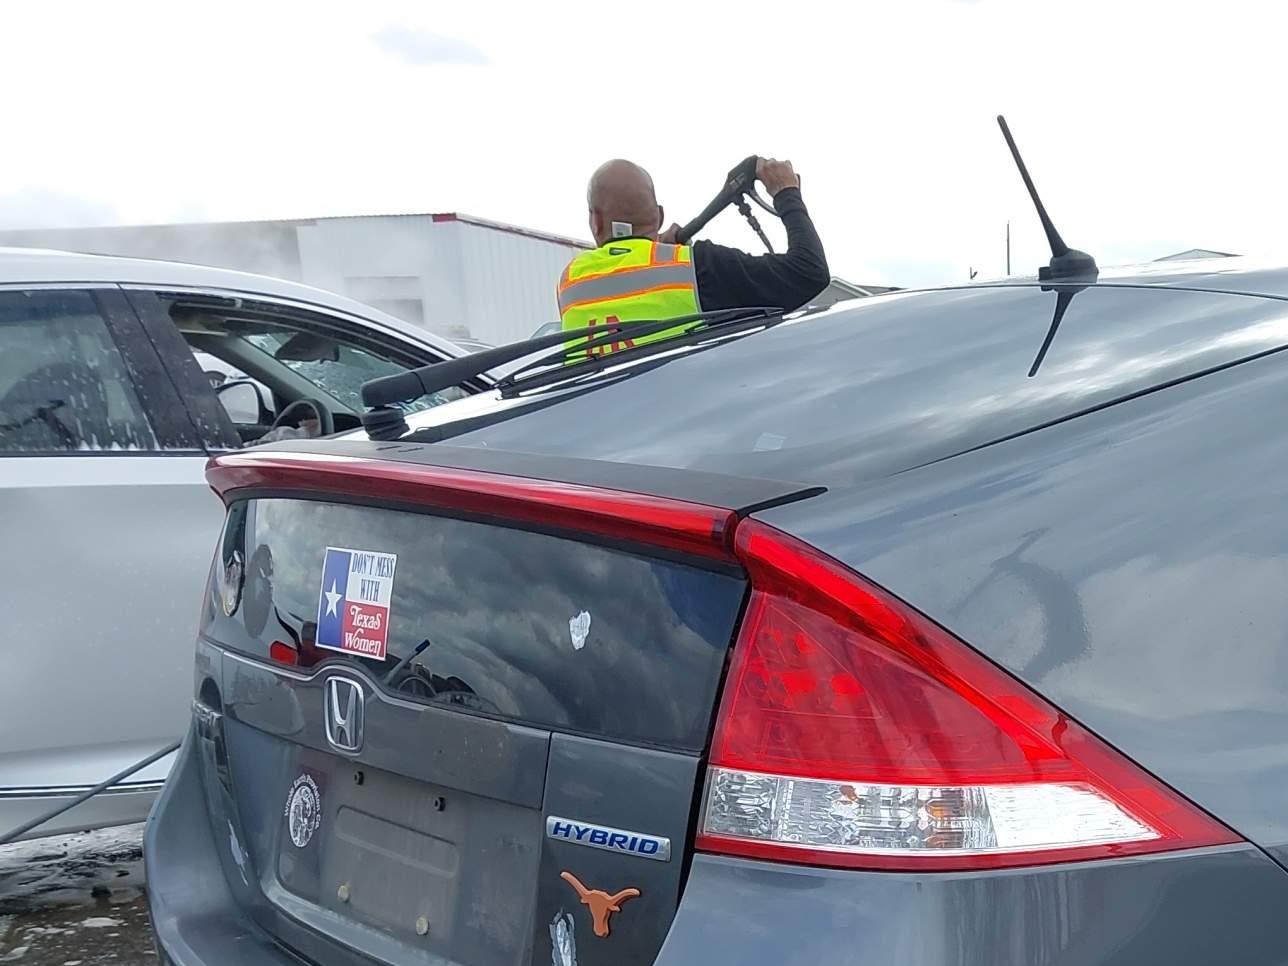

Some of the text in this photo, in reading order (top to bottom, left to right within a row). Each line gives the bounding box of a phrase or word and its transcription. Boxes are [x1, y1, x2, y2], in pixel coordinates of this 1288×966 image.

[351, 553, 394, 578] DON'T MESS
[361, 579, 380, 602] WITH
[350, 605, 382, 630] Texas
[345, 628, 381, 657] Women
[552, 821, 659, 855] HYBRID
